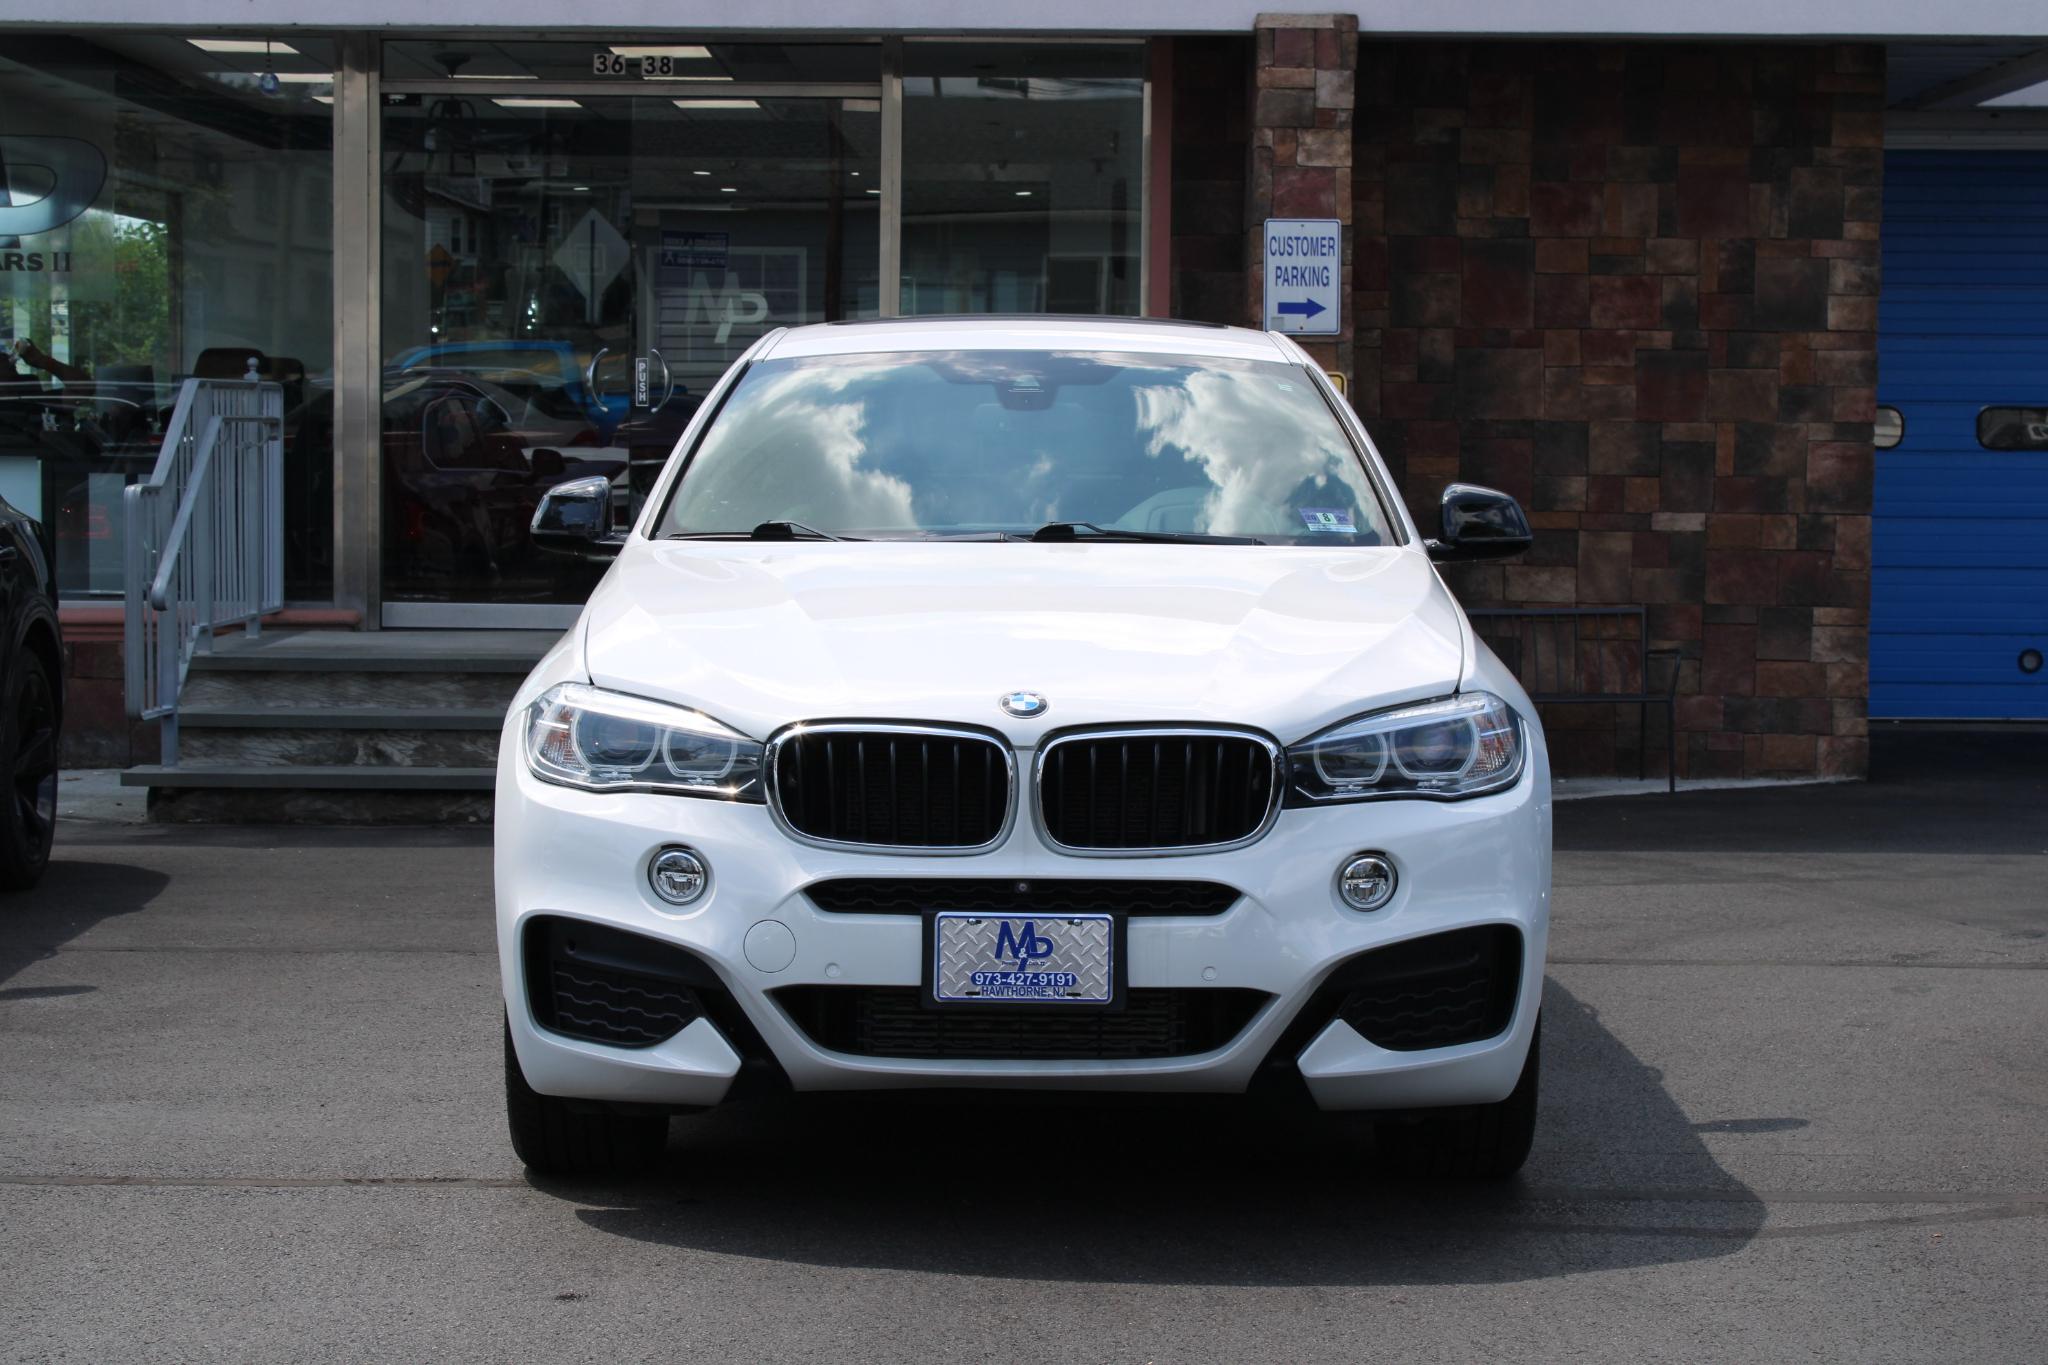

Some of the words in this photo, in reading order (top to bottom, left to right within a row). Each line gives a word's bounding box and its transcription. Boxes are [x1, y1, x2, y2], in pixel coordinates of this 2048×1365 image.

[1269, 236, 1335, 257] CUSTOMER
[1275, 266, 1330, 287] PARKING
[639, 362, 647, 402] PUSH
[975, 973, 1073, 986] 973-427-9191
[981, 986, 1051, 997] HAWTHORNE,
[1053, 987, 1066, 997] NJ
